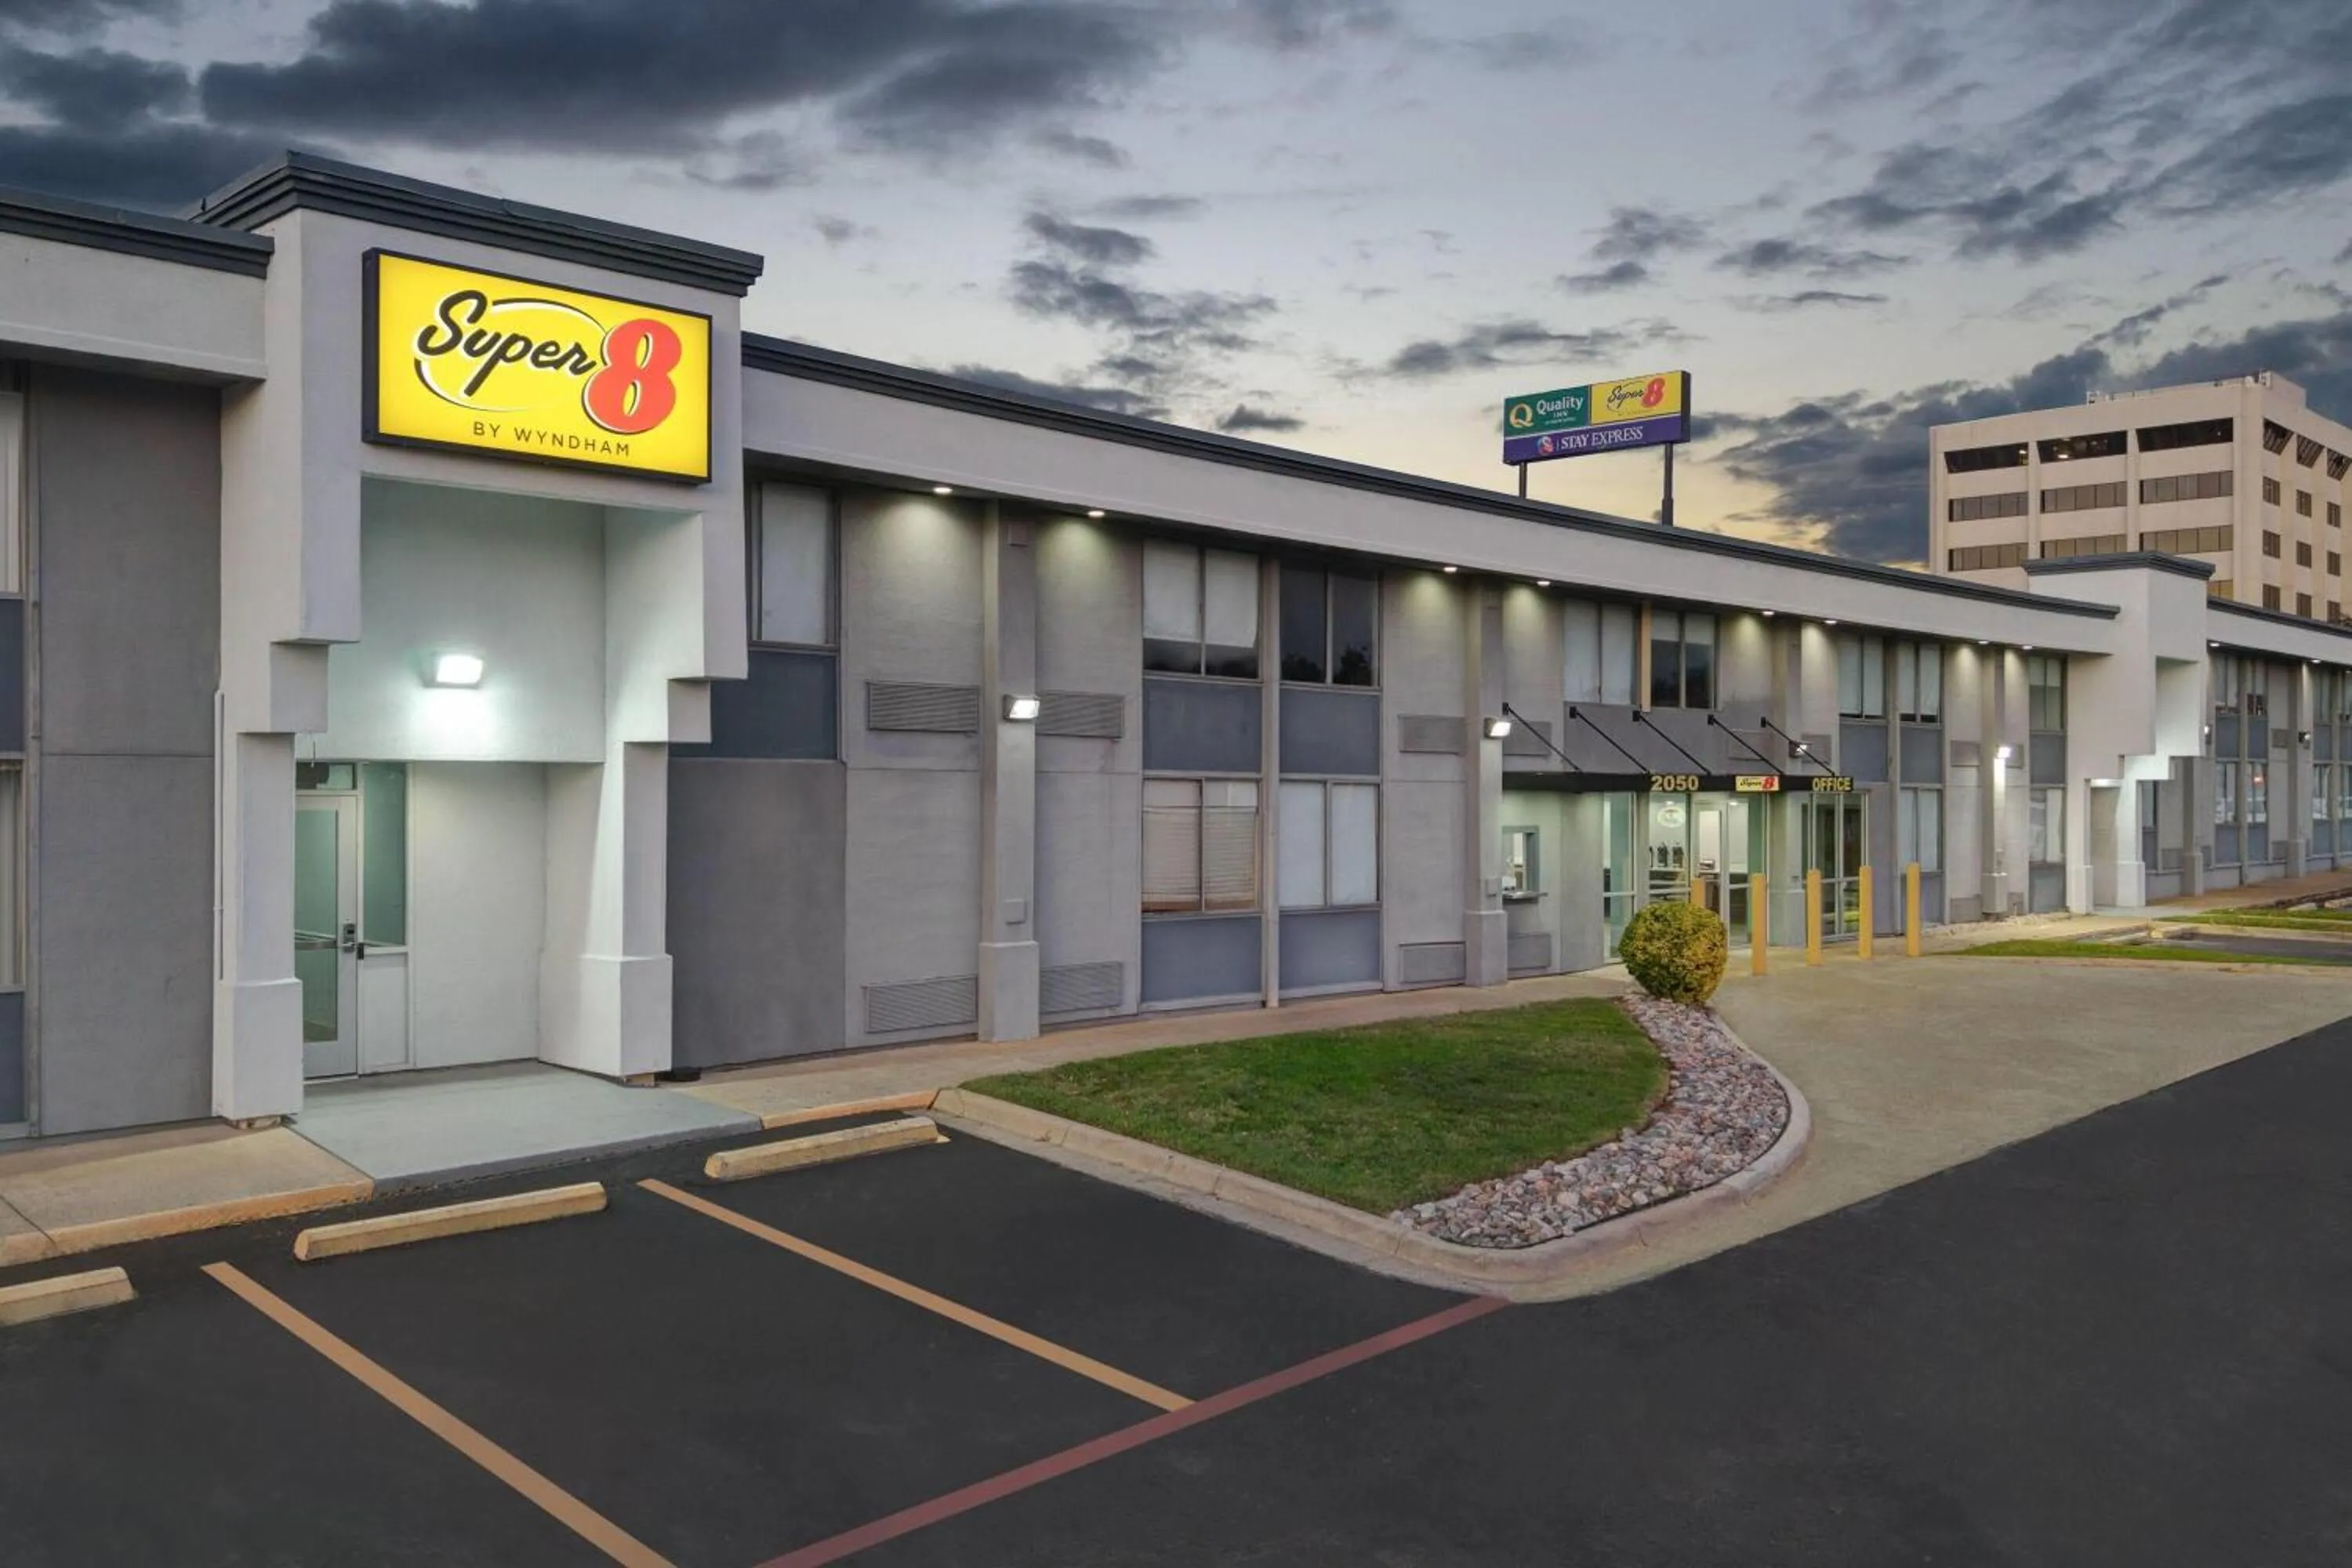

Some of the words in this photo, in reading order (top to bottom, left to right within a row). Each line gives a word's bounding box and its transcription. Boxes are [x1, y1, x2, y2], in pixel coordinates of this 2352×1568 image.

[417, 290, 597, 397] Super
[582, 318, 682, 435] 8
[1537, 396, 1584, 415] Quality
[1607, 385, 1644, 409] Super
[1642, 378, 1665, 408] 8
[1509, 402, 1534, 428] Q
[473, 421, 499, 437] BY
[514, 427, 630, 456] WYNDHAM
[1561, 434, 1589, 449] STAY
[1591, 426, 1643, 446] EXPRESS
[1651, 775, 1699, 792] 2050
[1812, 778, 1852, 791] OFFICE
